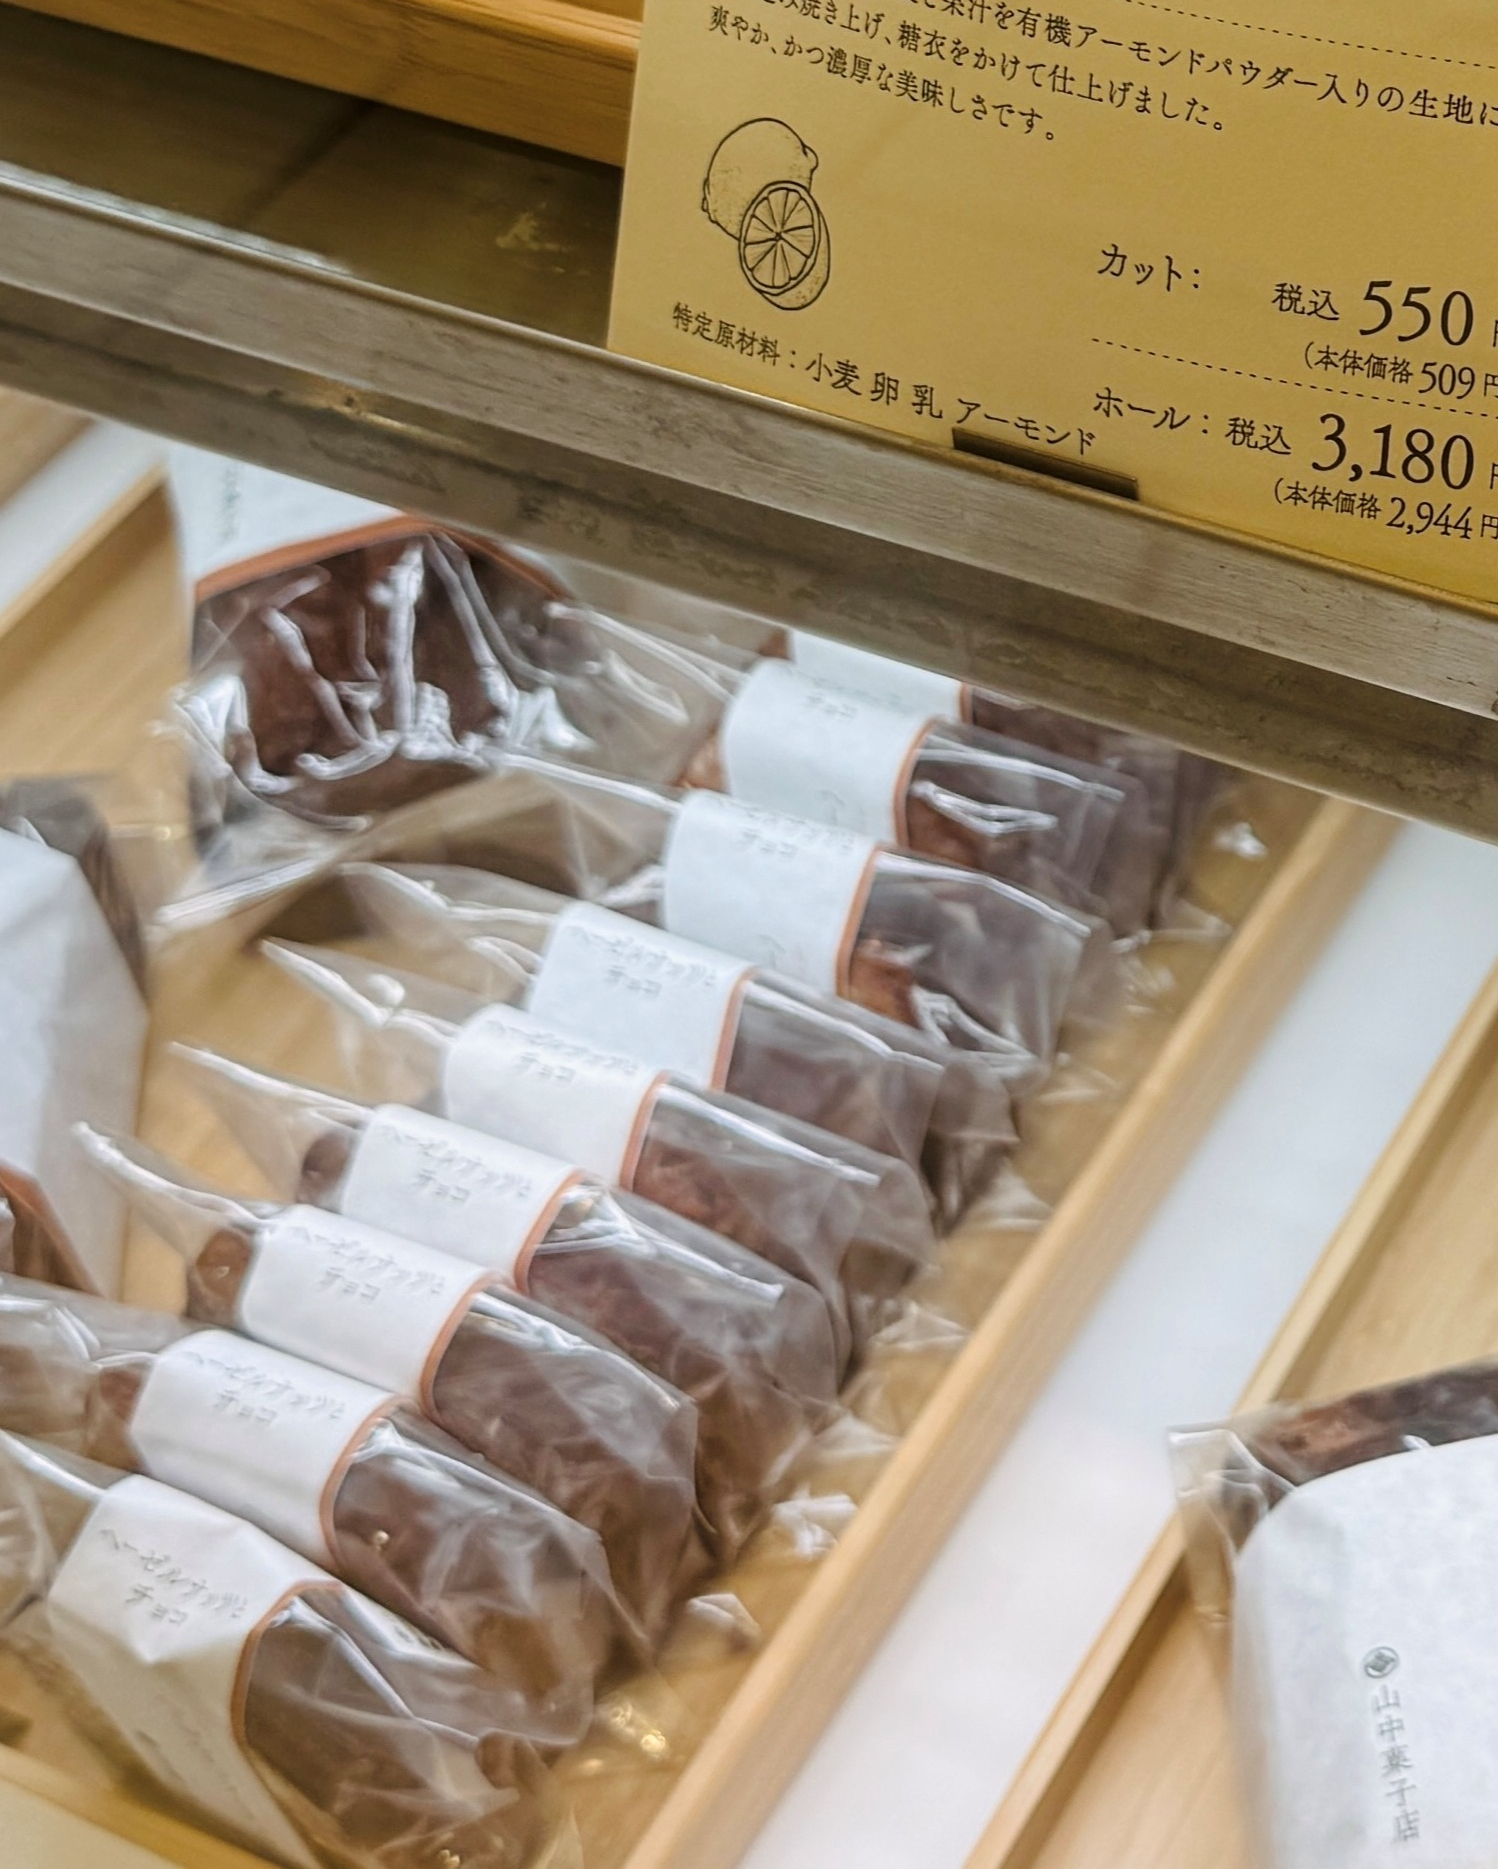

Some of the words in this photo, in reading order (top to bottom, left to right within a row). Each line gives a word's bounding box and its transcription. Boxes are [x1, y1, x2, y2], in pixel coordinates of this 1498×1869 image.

[708, 2, 1056, 143] 爽やか、かつ濃厚な美味しさです。
[1271, 281, 1341, 322] 税込
[1358, 279, 1475, 346] 550
[871, 371, 900, 405] 卵
[911, 385, 944, 421] 乳
[956, 397, 1096, 456] アーモンド
[1224, 415, 1292, 456] 税込
[1311, 412, 1476, 491] 3,180
[1370, 1684, 1420, 1845] 山中菓子店
